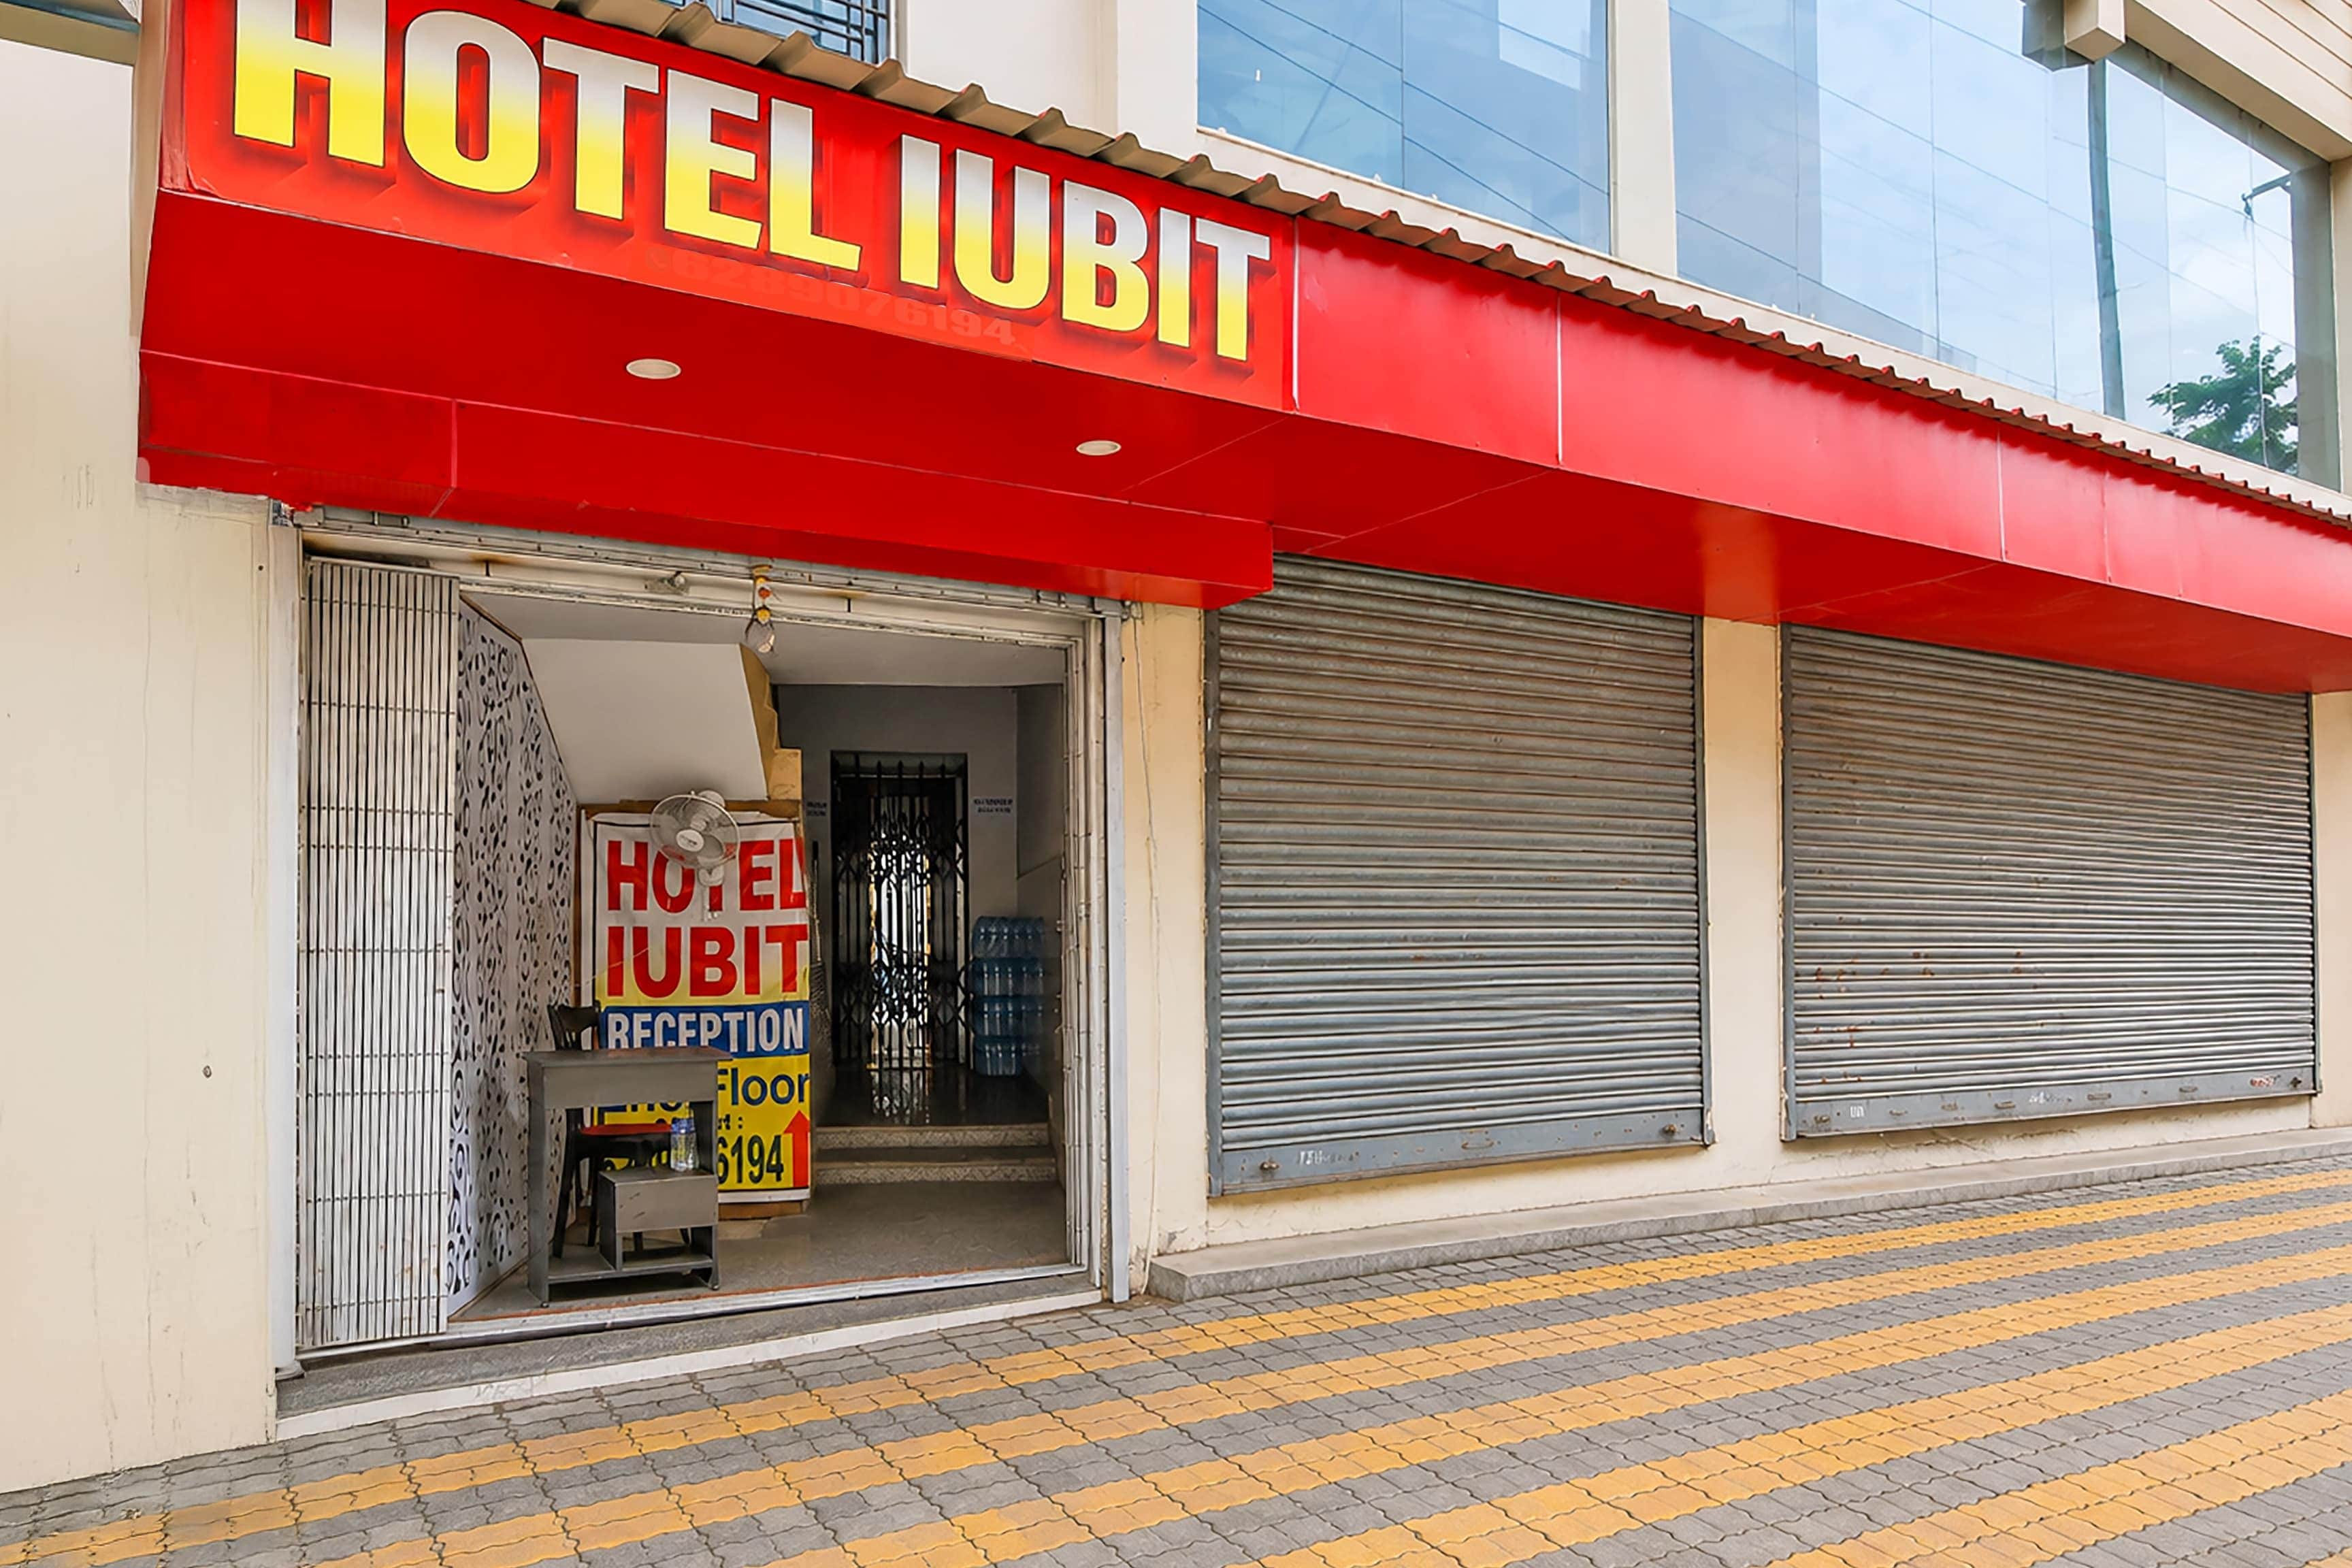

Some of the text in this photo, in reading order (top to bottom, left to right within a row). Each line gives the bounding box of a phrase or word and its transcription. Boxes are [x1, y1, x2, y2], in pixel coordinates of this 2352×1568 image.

[233, 0, 1271, 361] HOTEL IUBIT
[608, 924, 808, 998] IUBIT
[608, 1008, 803, 1052] RECEPTION
